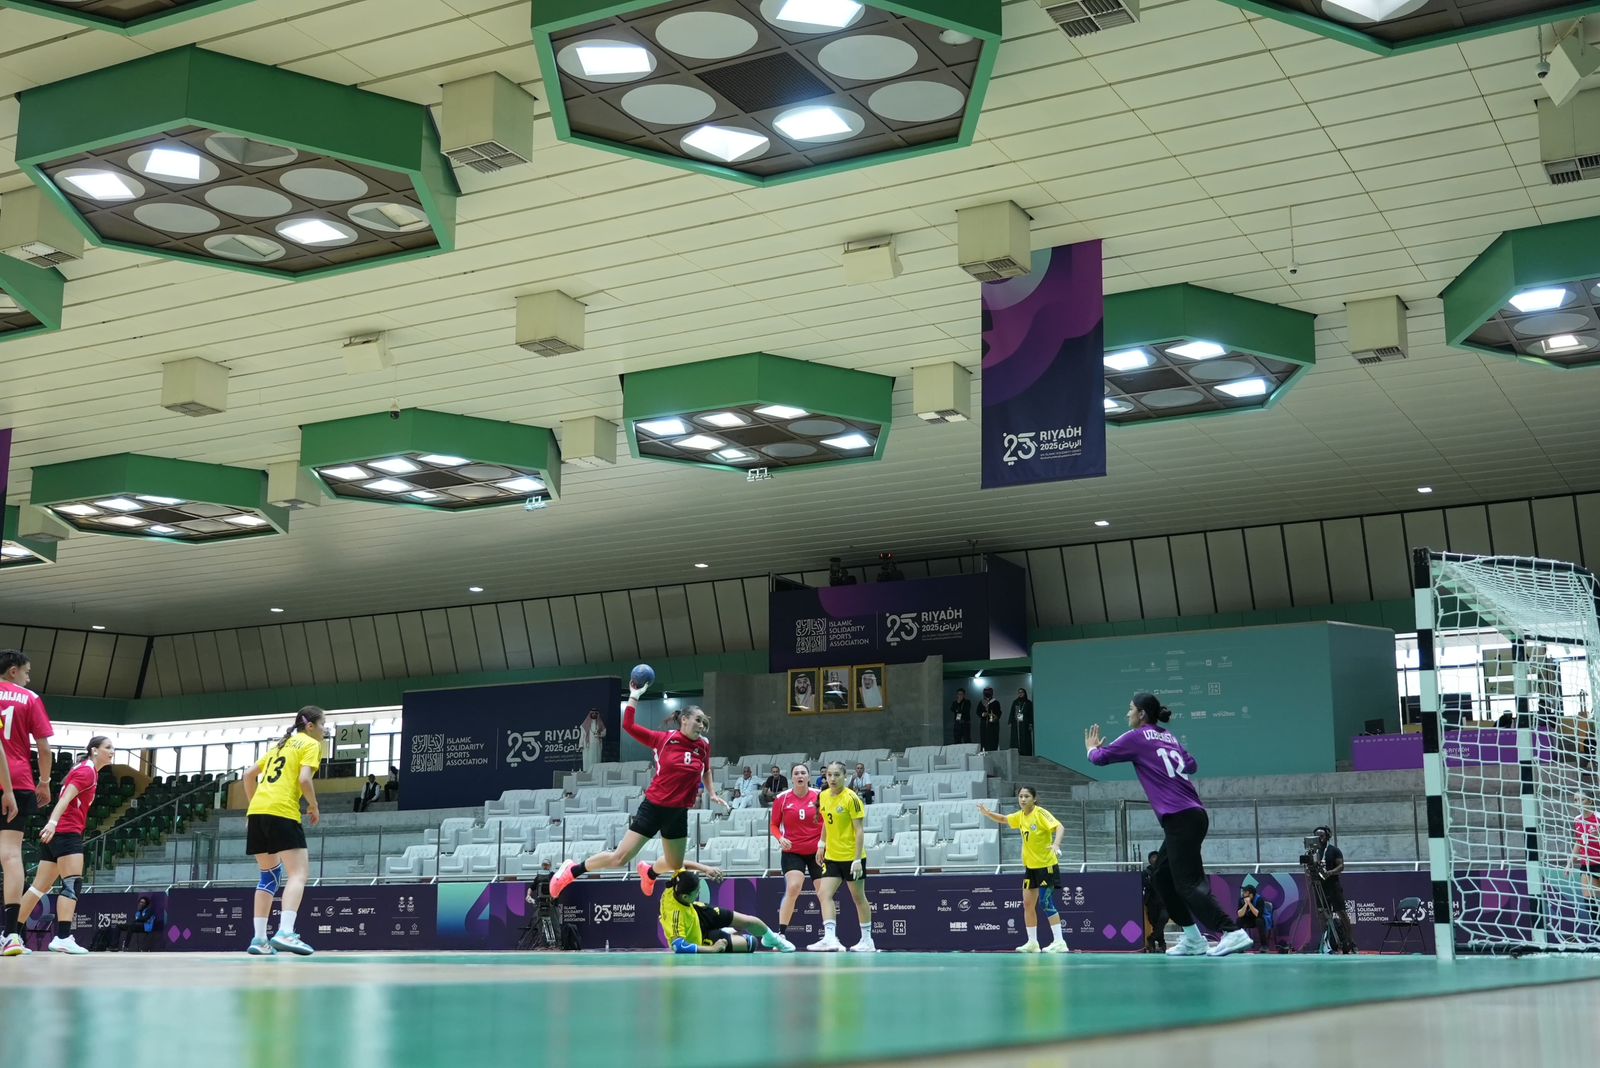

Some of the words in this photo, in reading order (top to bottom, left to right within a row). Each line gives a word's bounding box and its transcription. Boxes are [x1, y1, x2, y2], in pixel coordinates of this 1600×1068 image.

[1040, 425, 1082, 442] RIYADH
[1040, 442, 1058, 450] 2025
[1058, 440, 1082, 450] الرياض
[922, 607, 962, 622] RIYADH
[829, 625, 865, 634] SOLIDARITY
[830, 638, 869, 647] ASSOCIATION
[341, 728, 348, 741] 2
[545, 727, 580, 743] RIYAD
[446, 743, 484, 751] SOLIDARITY
[544, 744, 563, 752] 2025
[446, 758, 488, 766] ASSOCIATION
[684, 752, 691, 764] 8
[1156, 748, 1188, 780] 12
[799, 809, 806, 820] 9
[827, 813, 833, 824] 3
[613, 903, 635, 912] RIYADH
